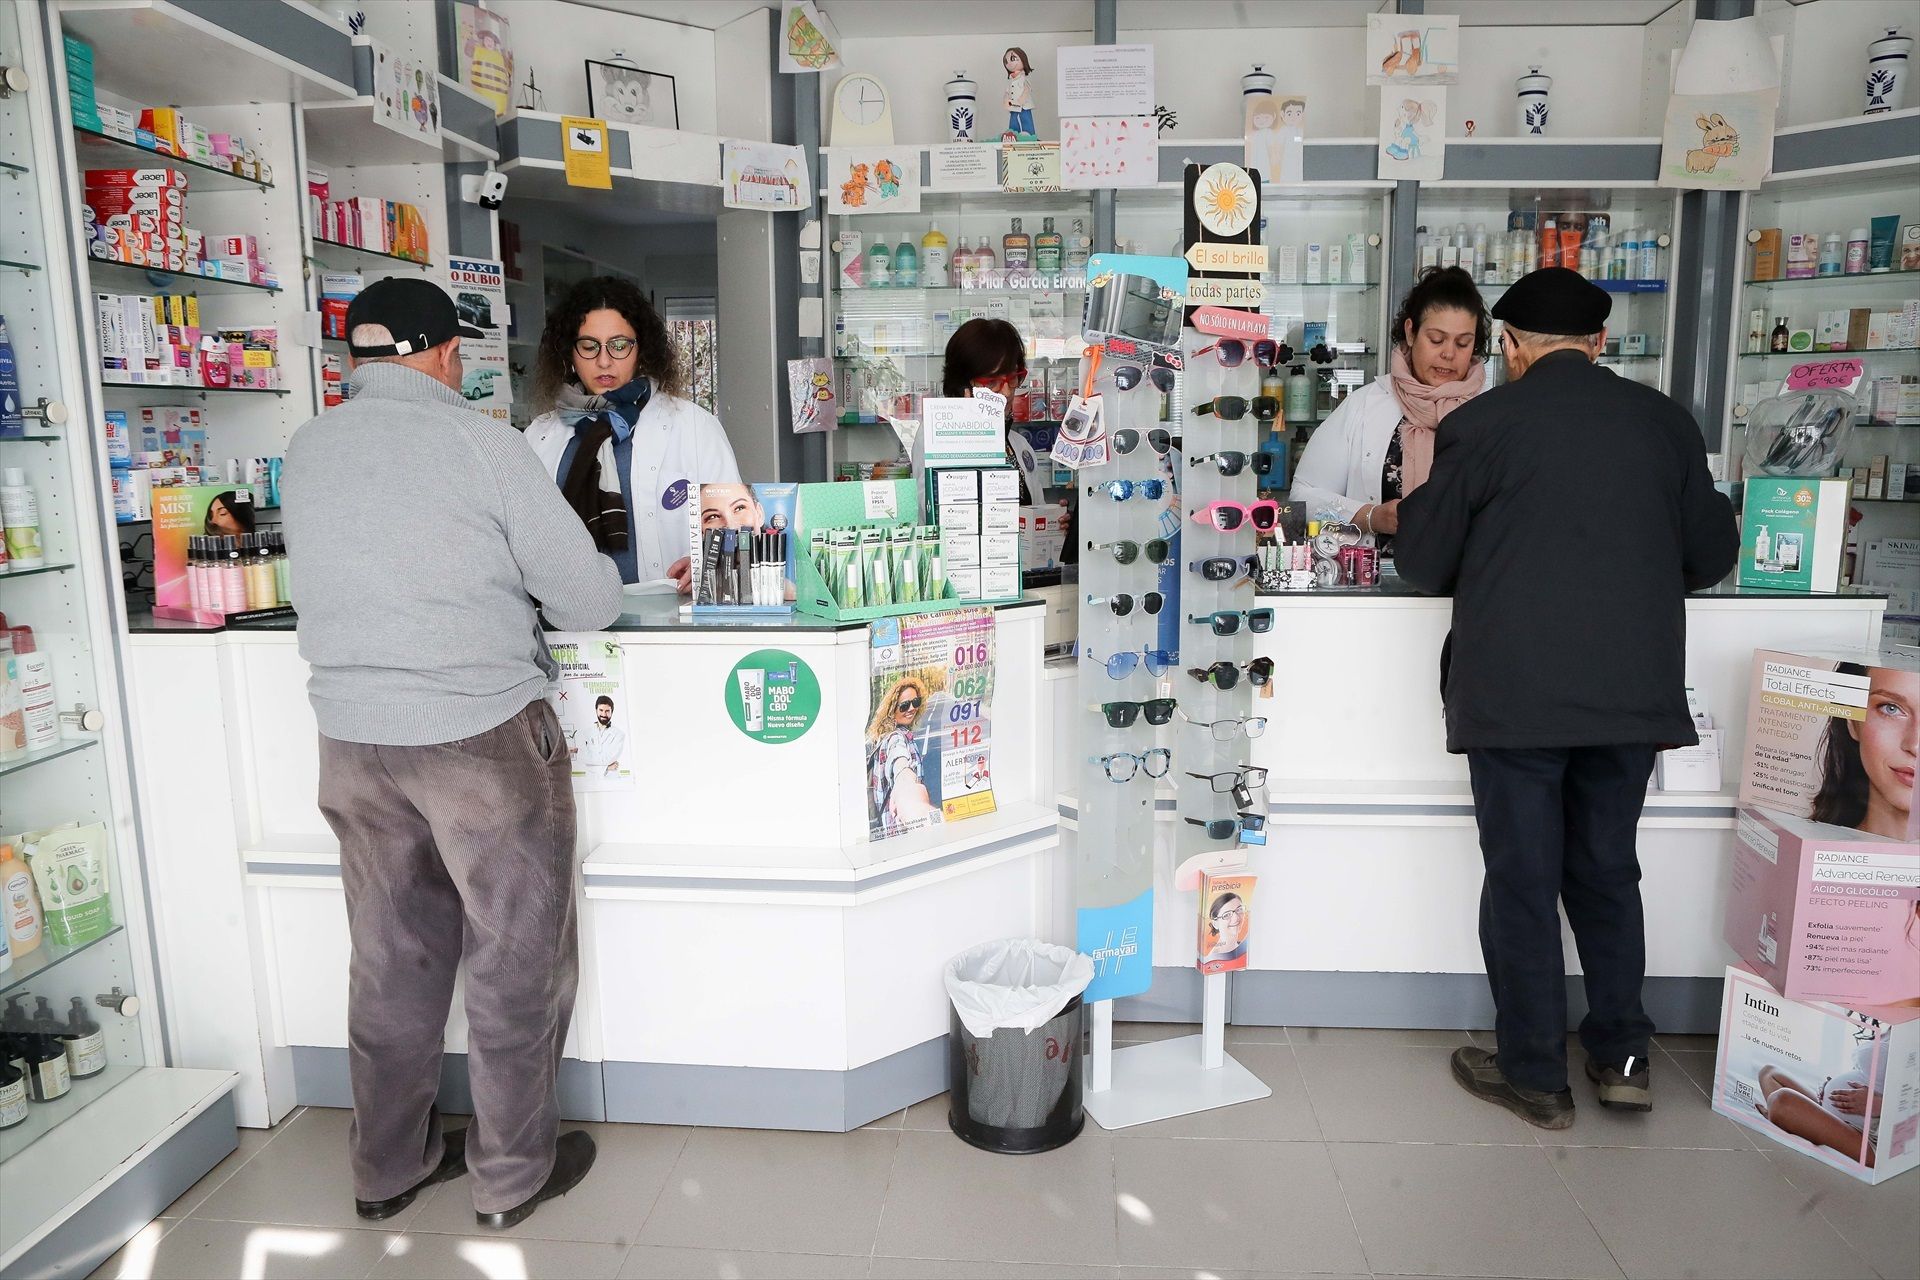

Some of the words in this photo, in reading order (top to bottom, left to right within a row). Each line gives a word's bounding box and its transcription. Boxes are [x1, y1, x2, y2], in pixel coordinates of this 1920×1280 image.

[1195, 249, 1207, 264] El
[1211, 250, 1229, 264] sol
[1232, 251, 1265, 265] brilla
[457, 261, 493, 273] TAXI
[451, 271, 460, 282] O
[463, 273, 500, 286] RUBIO
[979, 277, 1006, 289] Pilar
[1190, 283, 1222, 298] todas
[1226, 285, 1262, 302] partes
[1199, 313, 1211, 326] NO
[1211, 313, 1228, 329] SÓLO
[1228, 318, 1237, 329] EN
[1237, 319, 1246, 331] LA
[1247, 320, 1267, 334] PLAYA
[101, 311, 109, 353] SENSODYNE
[1794, 361, 1856, 379] OFERTA
[975, 391, 1005, 406] OFERTA
[935, 412, 953, 421] CBD
[935, 422, 995, 430] CANNABIDIOL
[689, 485, 697, 516] EYES
[160, 502, 194, 515] MIST
[692, 522, 700, 592] SENSITIVE
[954, 643, 987, 666] 016
[26, 662, 45, 670] Eucerin
[1766, 664, 1812, 679] RADIANCE
[768, 686, 795, 695] MABO
[954, 675, 987, 699] 062
[1765, 678, 1794, 693] Total
[1795, 683, 1836, 700] Effects
[774, 695, 791, 703] DOL
[1763, 695, 1796, 708] GLOBAL
[1797, 701, 1852, 717] ANTI-AGING
[770, 703, 788, 711] CBD
[950, 700, 981, 722] 091
[1760, 707, 1818, 724] TRATAMIENTO
[1758, 717, 1803, 731] INTENSIVO
[951, 725, 981, 747] 112
[1757, 727, 1799, 741] ANTIEDAD
[1755, 744, 1778, 754] Repara
[1790, 752, 1812, 761] signos
[1752, 781, 1774, 791] Unifica
[1817, 853, 1869, 864] RADIANCE
[1815, 868, 1873, 882] Advanced
[1211, 884, 1241, 892] presbicia
[1846, 885, 1899, 897] GLICÓLICO
[1809, 898, 1846, 907] EFECTO
[1847, 899, 1888, 909] PEELING
[1808, 922, 1834, 930] Exfolia
[1806, 933, 1840, 941] Renueva
[1744, 992, 1779, 1017] Intim
[1742, 1010, 1766, 1025] Contigo
[1767, 1020, 1775, 1028] en
[1777, 1023, 1792, 1034] cada
[1760, 1024, 1767, 1033] de
[1769, 1028, 1776, 1037] tu
[1777, 1032, 1790, 1042] vida
[1752, 1037, 1760, 1045] de
[1761, 1040, 1784, 1054] nuevos
[1785, 1050, 1802, 1062] retos
